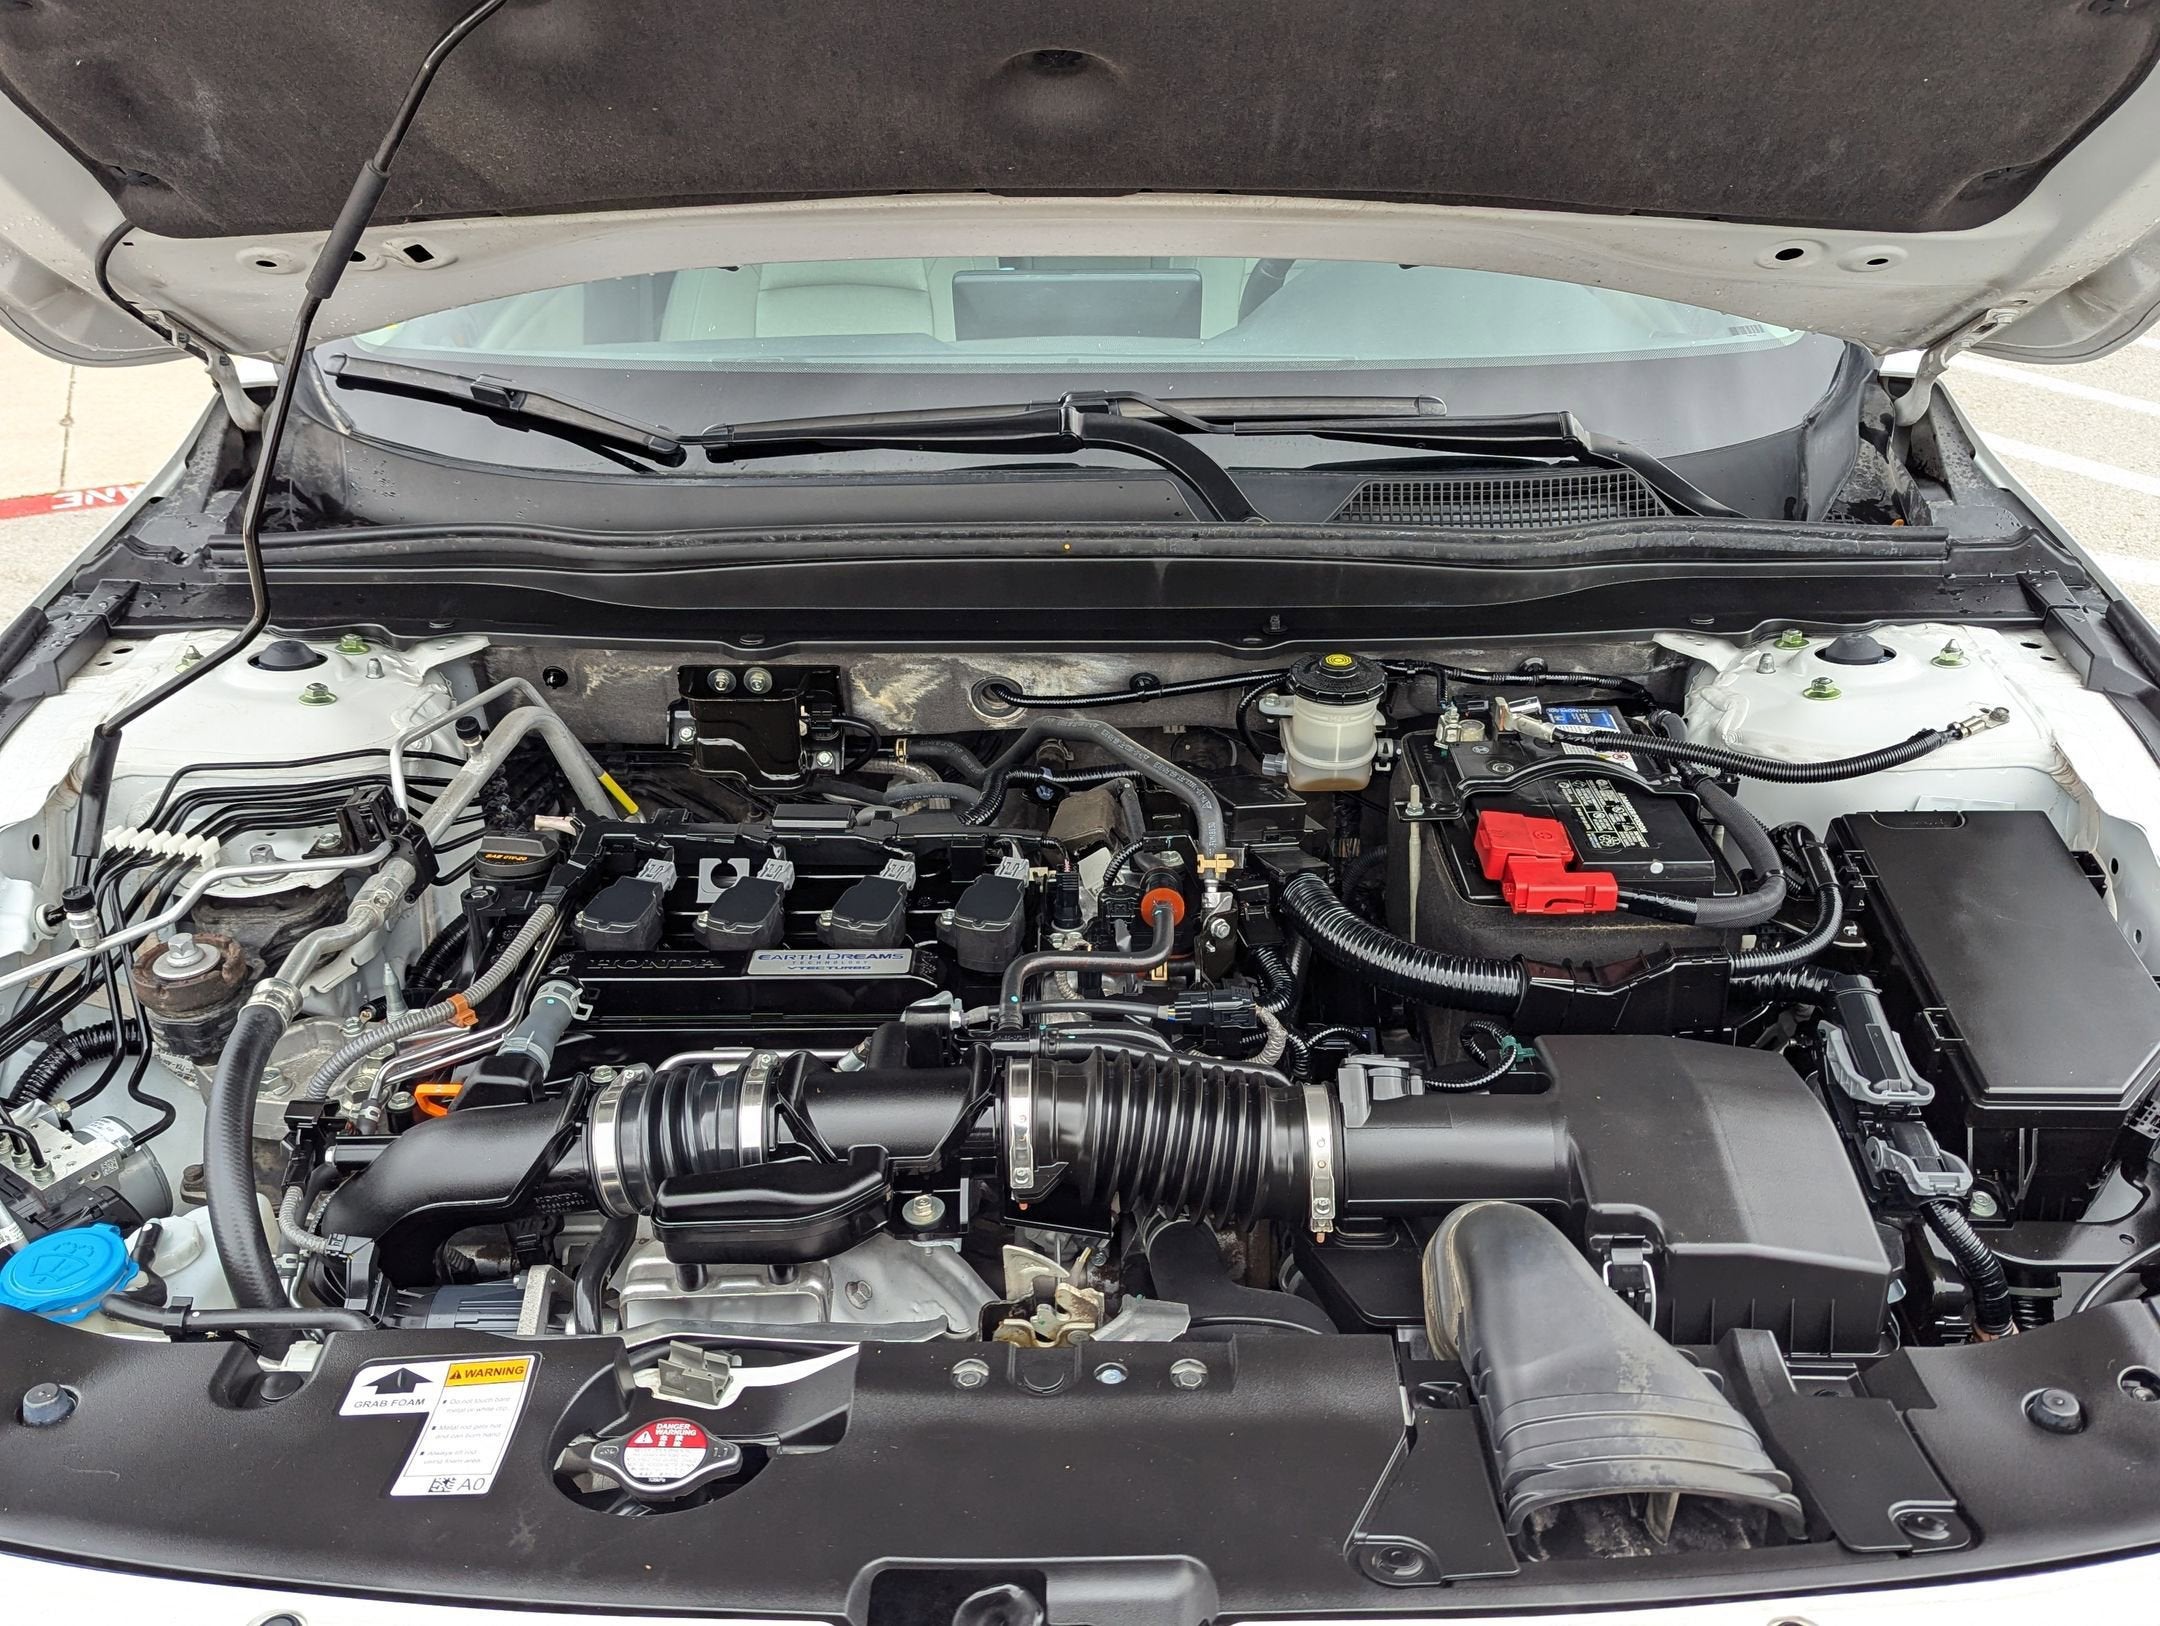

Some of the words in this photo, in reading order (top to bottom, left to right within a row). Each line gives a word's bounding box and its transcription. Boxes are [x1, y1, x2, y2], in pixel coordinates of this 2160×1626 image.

[51, 485, 140, 510] ANE
[587, 959, 726, 969] HONDA
[464, 1366, 524, 1379] WARNING
[353, 1399, 388, 1408] GRAB
[390, 1398, 426, 1407] FOAM
[457, 1477, 486, 1491] A0
